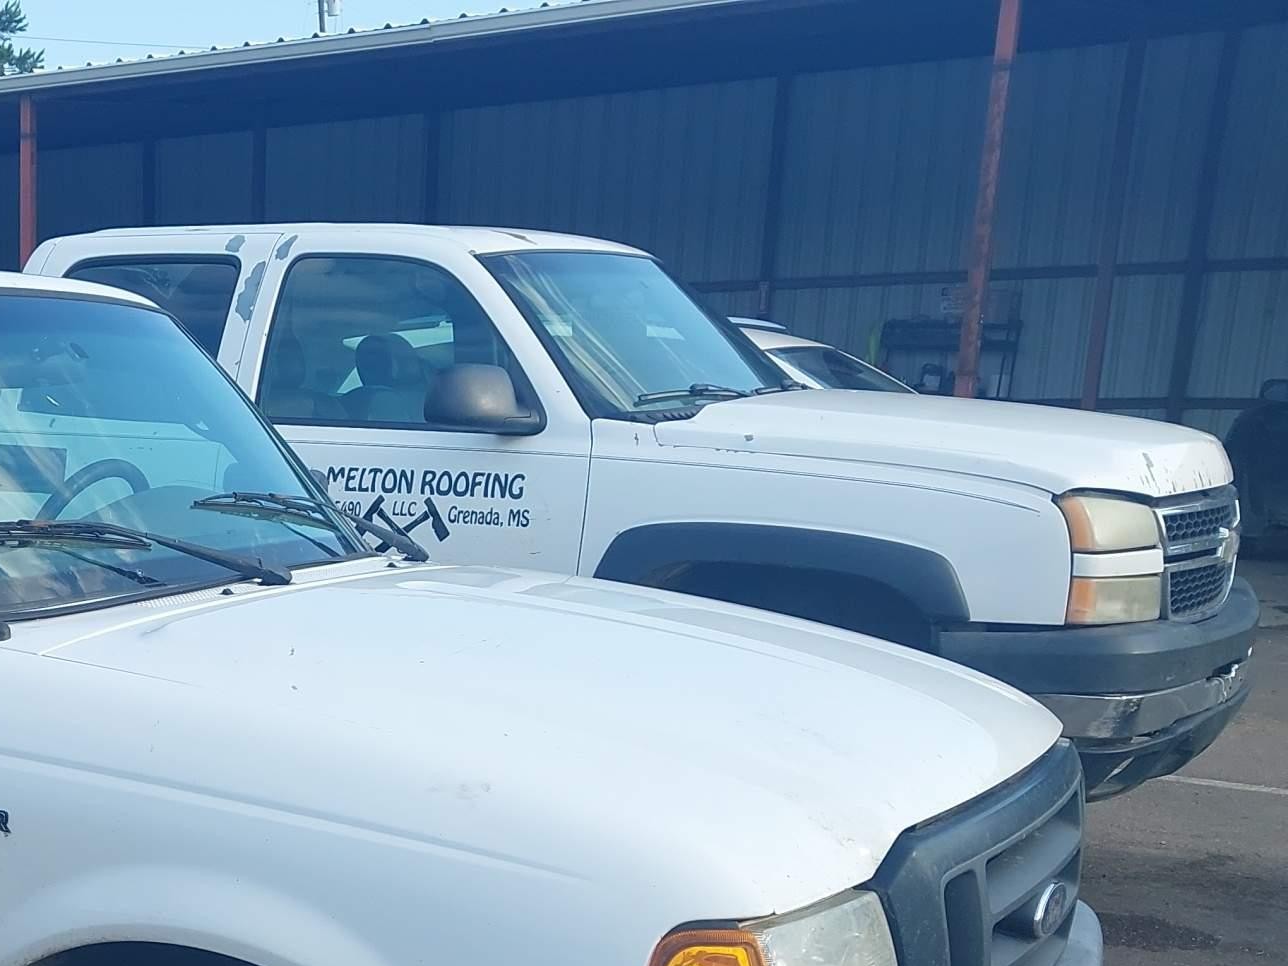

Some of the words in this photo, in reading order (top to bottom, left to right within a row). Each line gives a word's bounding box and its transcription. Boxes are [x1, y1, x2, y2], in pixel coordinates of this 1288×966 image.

[327, 466, 415, 494] MELTON
[420, 470, 526, 500] ROOFING
[392, 501, 418, 517] LLC
[448, 505, 504, 528] Grenada,
[508, 508, 530, 528] MS
